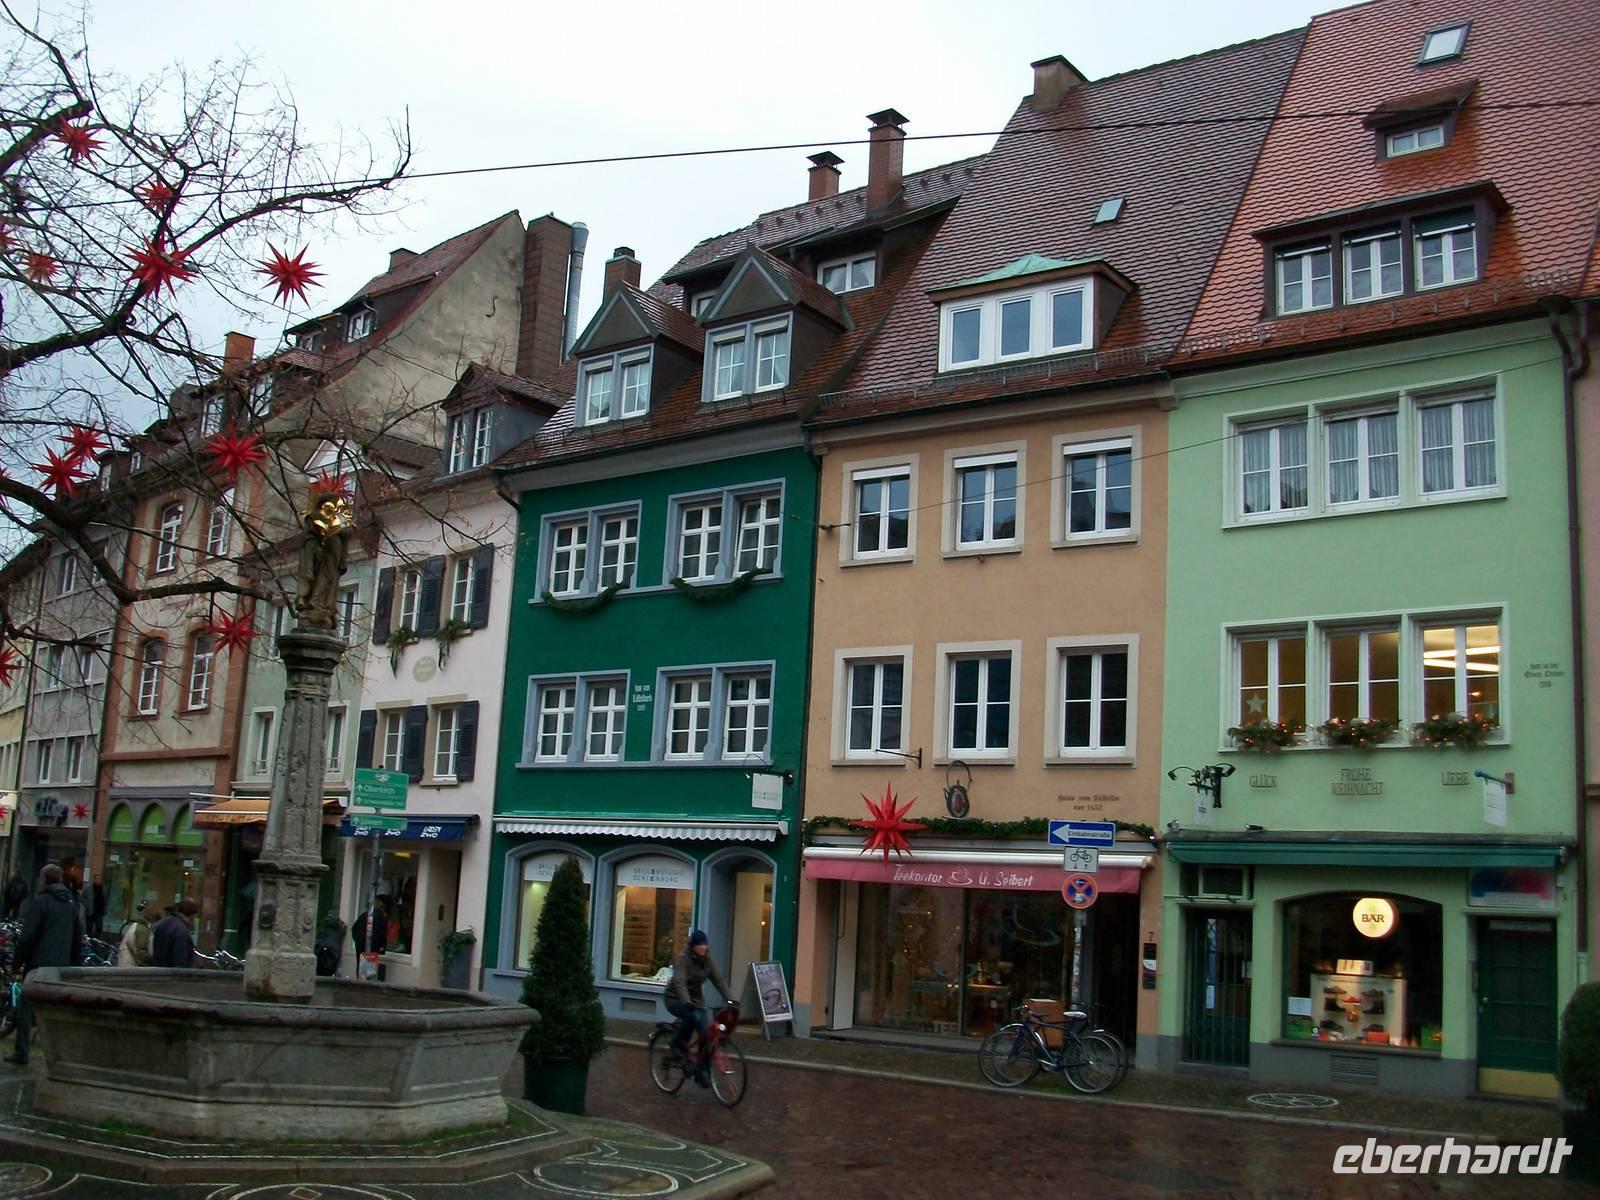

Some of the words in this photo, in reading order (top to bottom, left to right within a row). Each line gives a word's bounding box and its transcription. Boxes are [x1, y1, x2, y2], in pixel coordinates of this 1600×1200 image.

[1340, 768, 1371, 781] FROHE
[1442, 771, 1469, 786] LIEBE
[1068, 830, 1110, 838] Einbahnstraße
[893, 864, 943, 883] Teekontor
[994, 871, 1033, 887] Seibert
